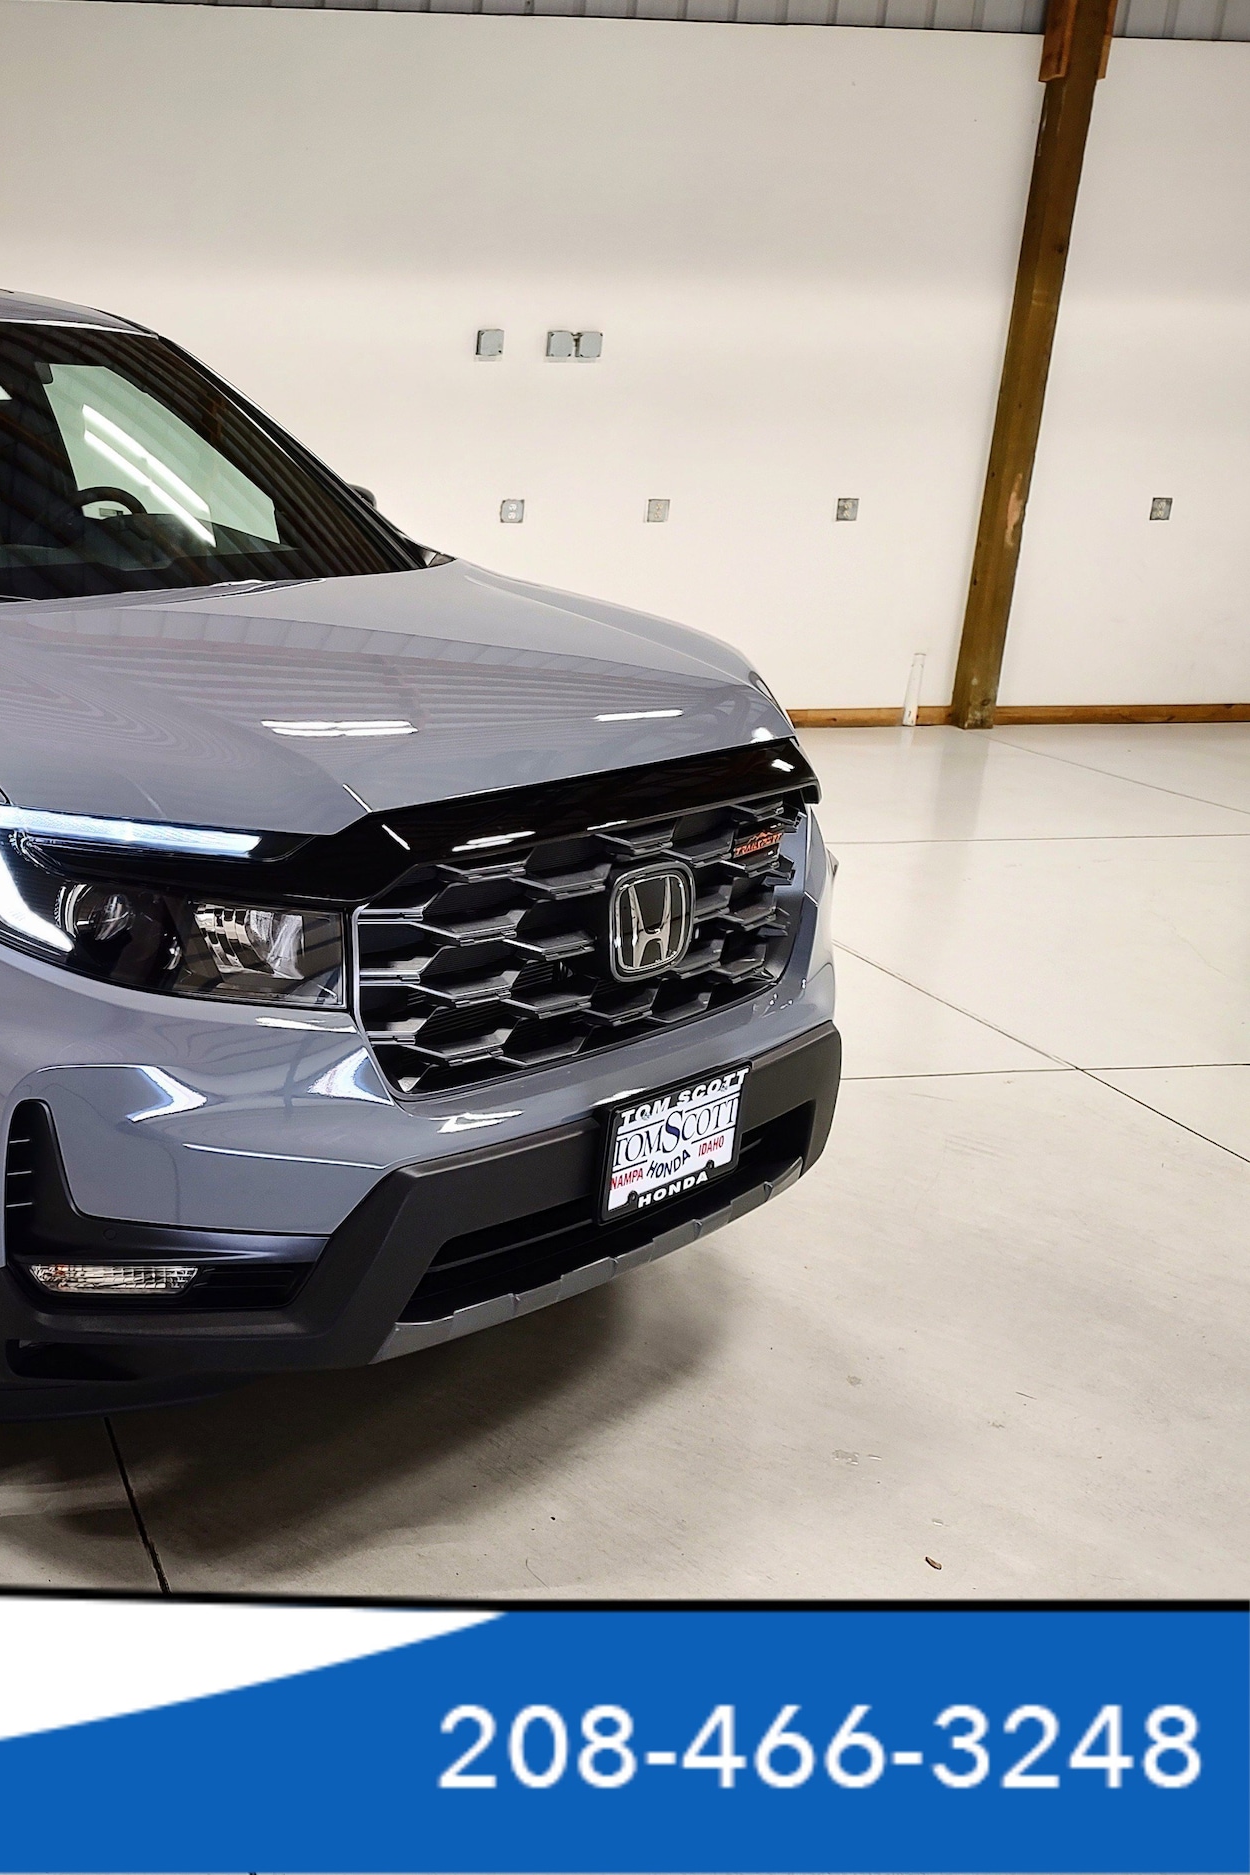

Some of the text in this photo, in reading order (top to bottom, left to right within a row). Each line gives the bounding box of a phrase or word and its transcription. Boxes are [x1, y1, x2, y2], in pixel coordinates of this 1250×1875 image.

[620, 1068, 750, 1127] TOM SCOTT
[610, 1135, 725, 1191] NAMPA HONDA IDAHO
[637, 1170, 709, 1209] HONDA
